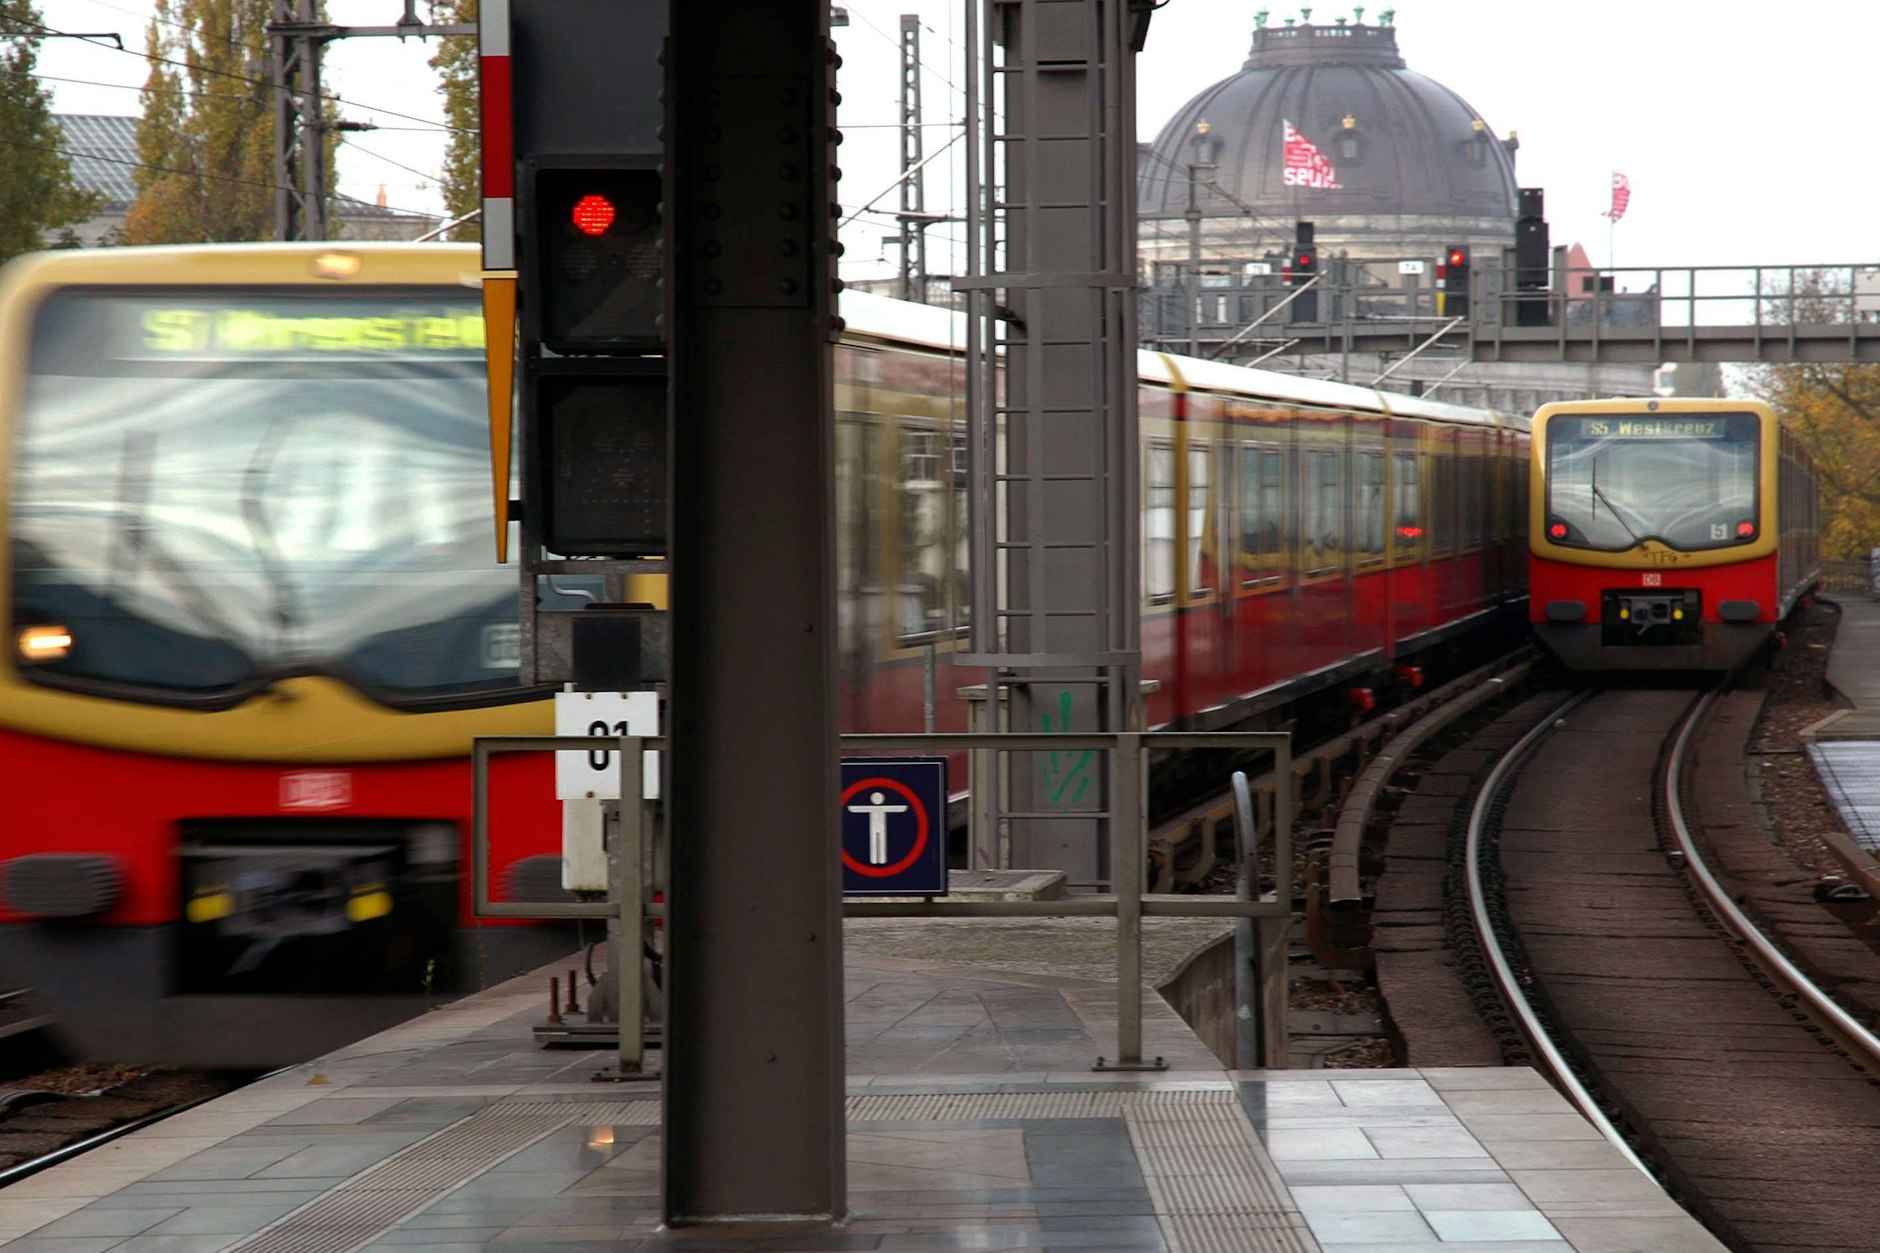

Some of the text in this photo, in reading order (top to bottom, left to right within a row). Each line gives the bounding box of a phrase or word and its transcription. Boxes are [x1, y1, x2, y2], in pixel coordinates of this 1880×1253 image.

[1590, 421, 1715, 436] S5 Westkreuz
[1713, 523, 1724, 538] 5
